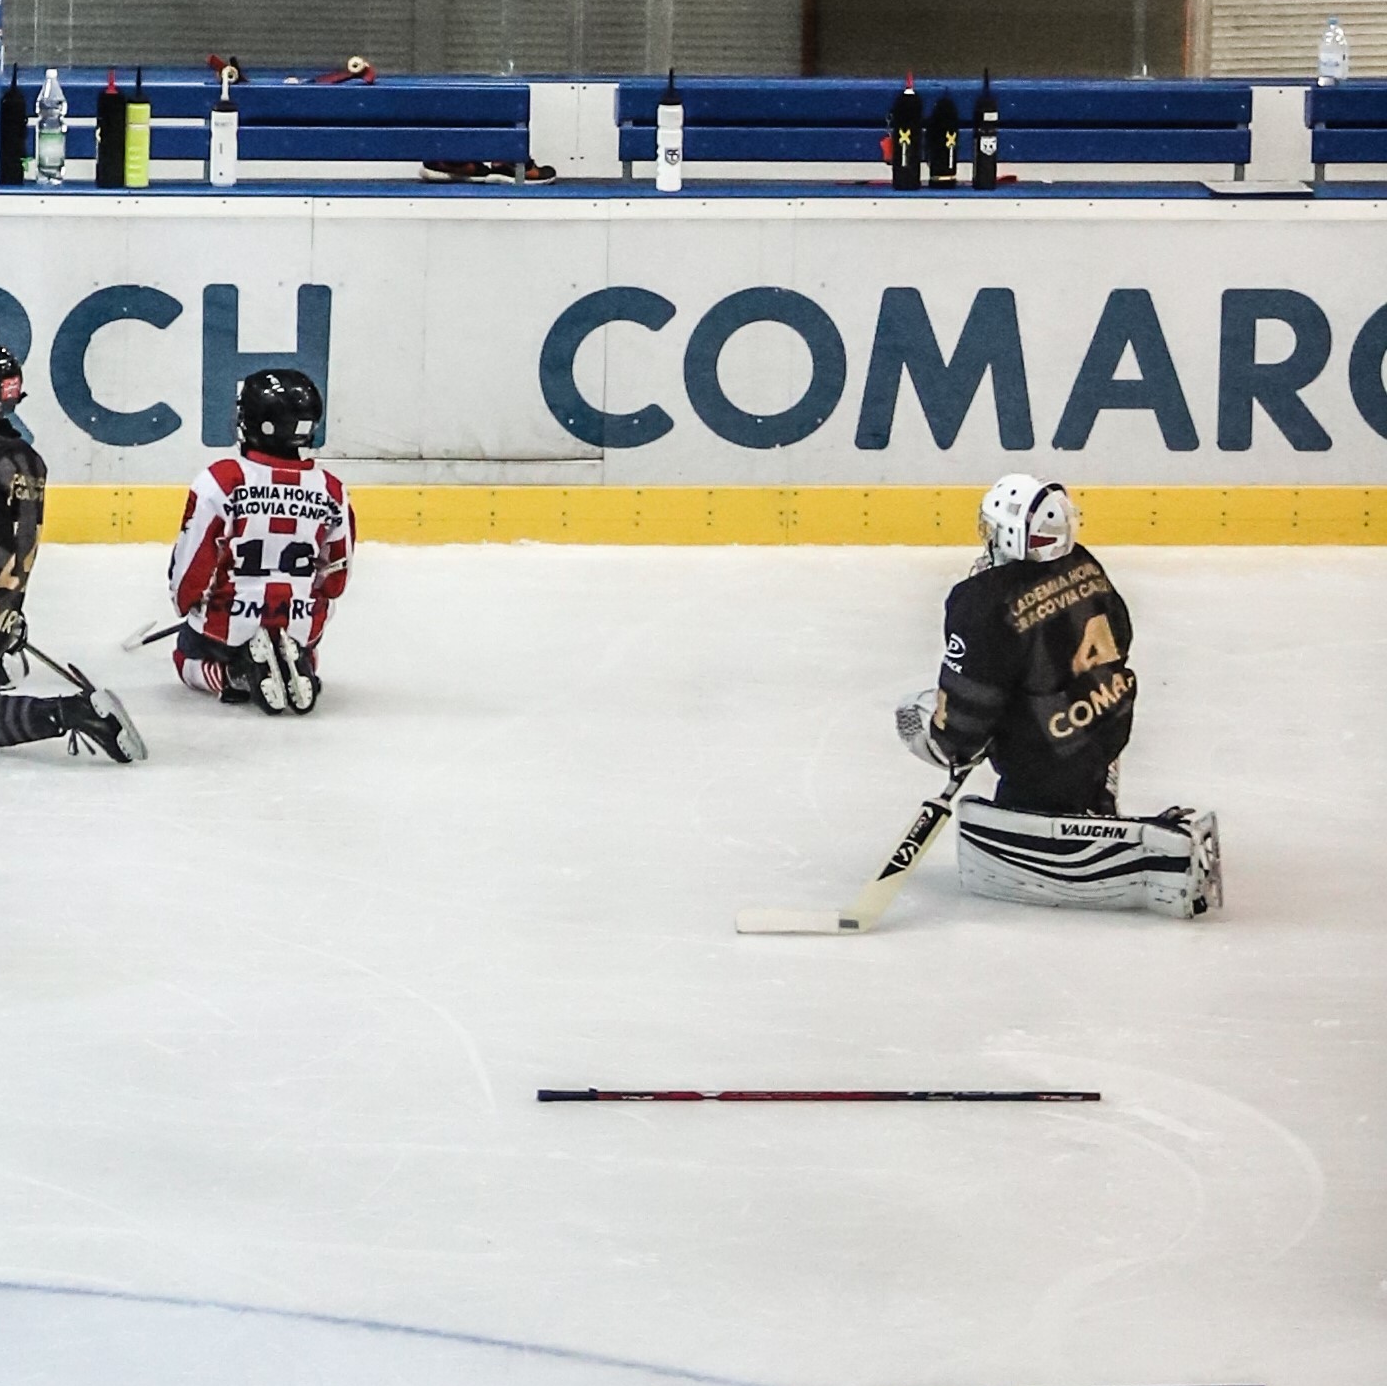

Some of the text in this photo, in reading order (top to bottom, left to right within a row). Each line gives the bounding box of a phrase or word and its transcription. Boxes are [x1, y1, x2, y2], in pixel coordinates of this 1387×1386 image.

[538, 286, 1387, 453] COMAR
[1071, 612, 1122, 678] 4
[1060, 823, 1128, 839] VAUGHN
